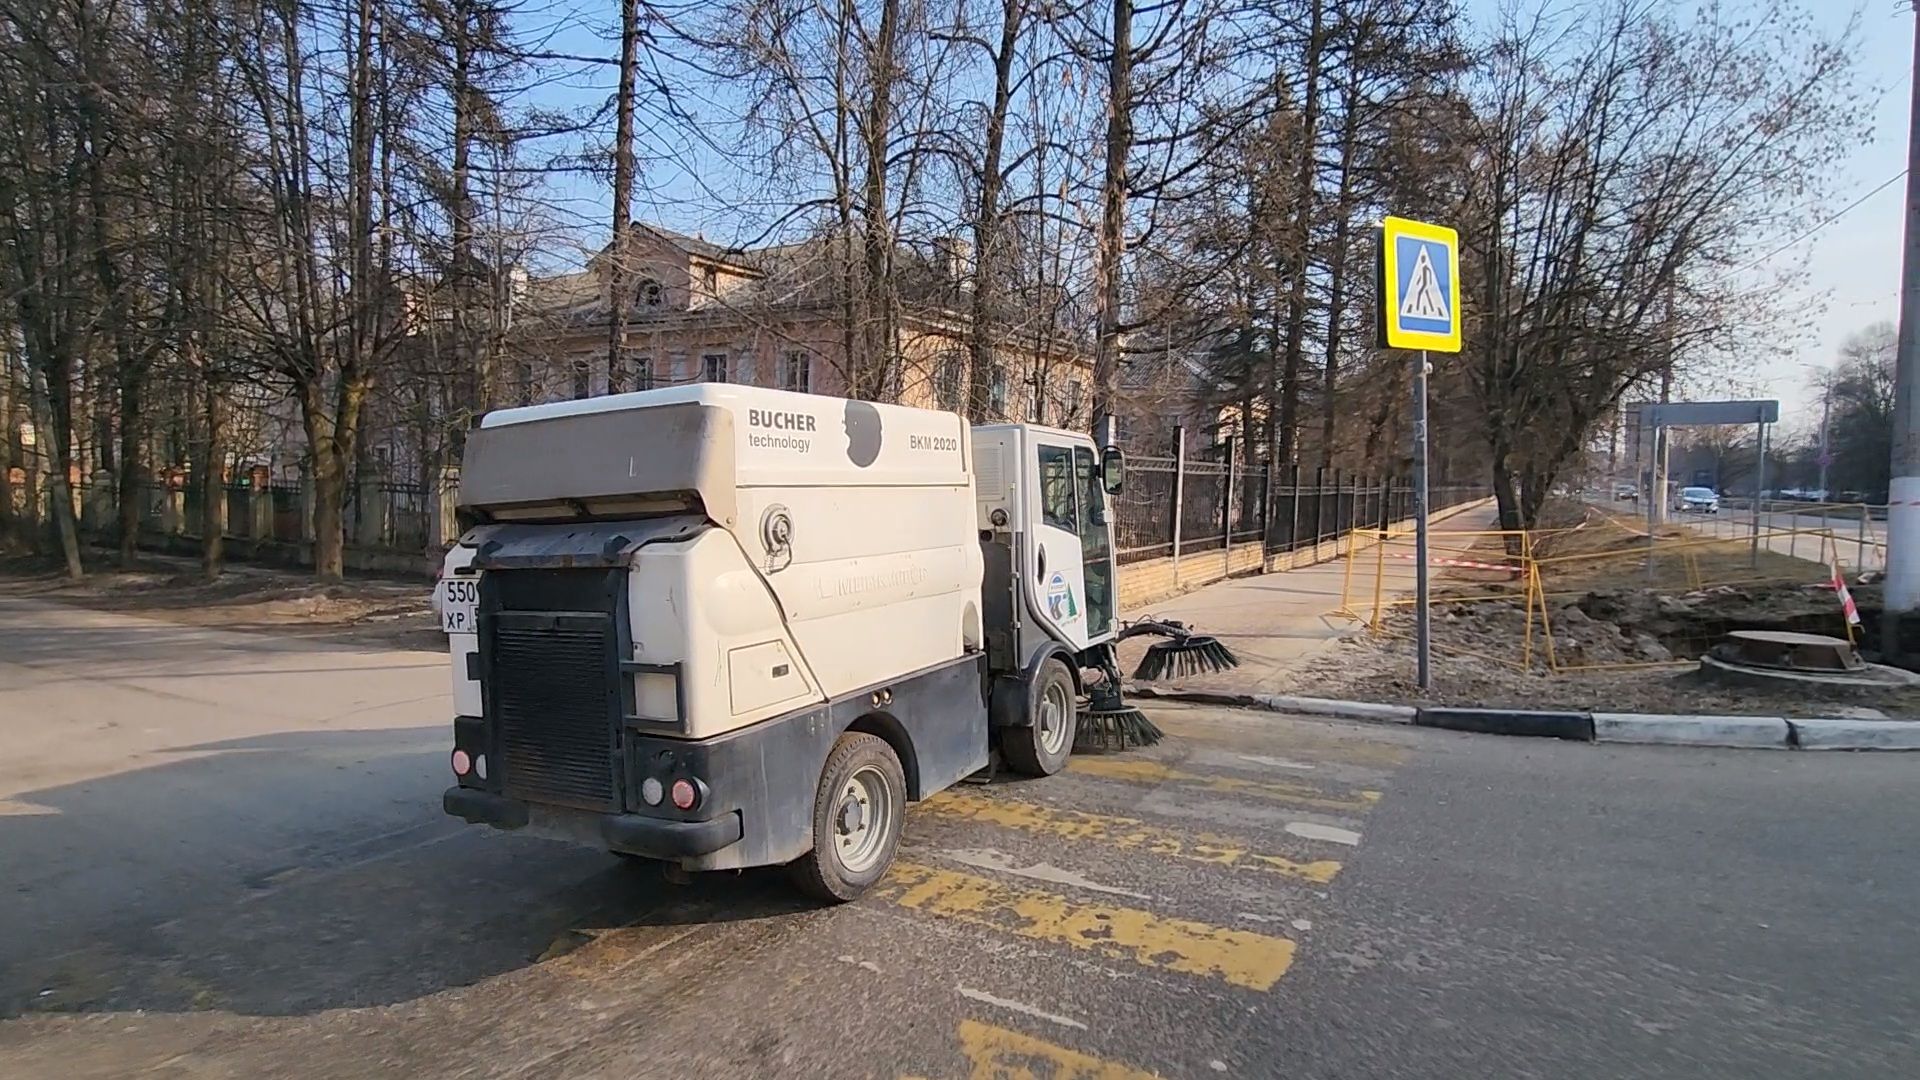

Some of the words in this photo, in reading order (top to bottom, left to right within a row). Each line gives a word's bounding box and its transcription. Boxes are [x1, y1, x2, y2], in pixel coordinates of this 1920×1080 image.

[749, 409, 816, 432] BUCHER
[749, 433, 811, 453] technology
[910, 435, 931, 450] BKM
[933, 437, 957, 451] 2020
[448, 581, 479, 603] 550
